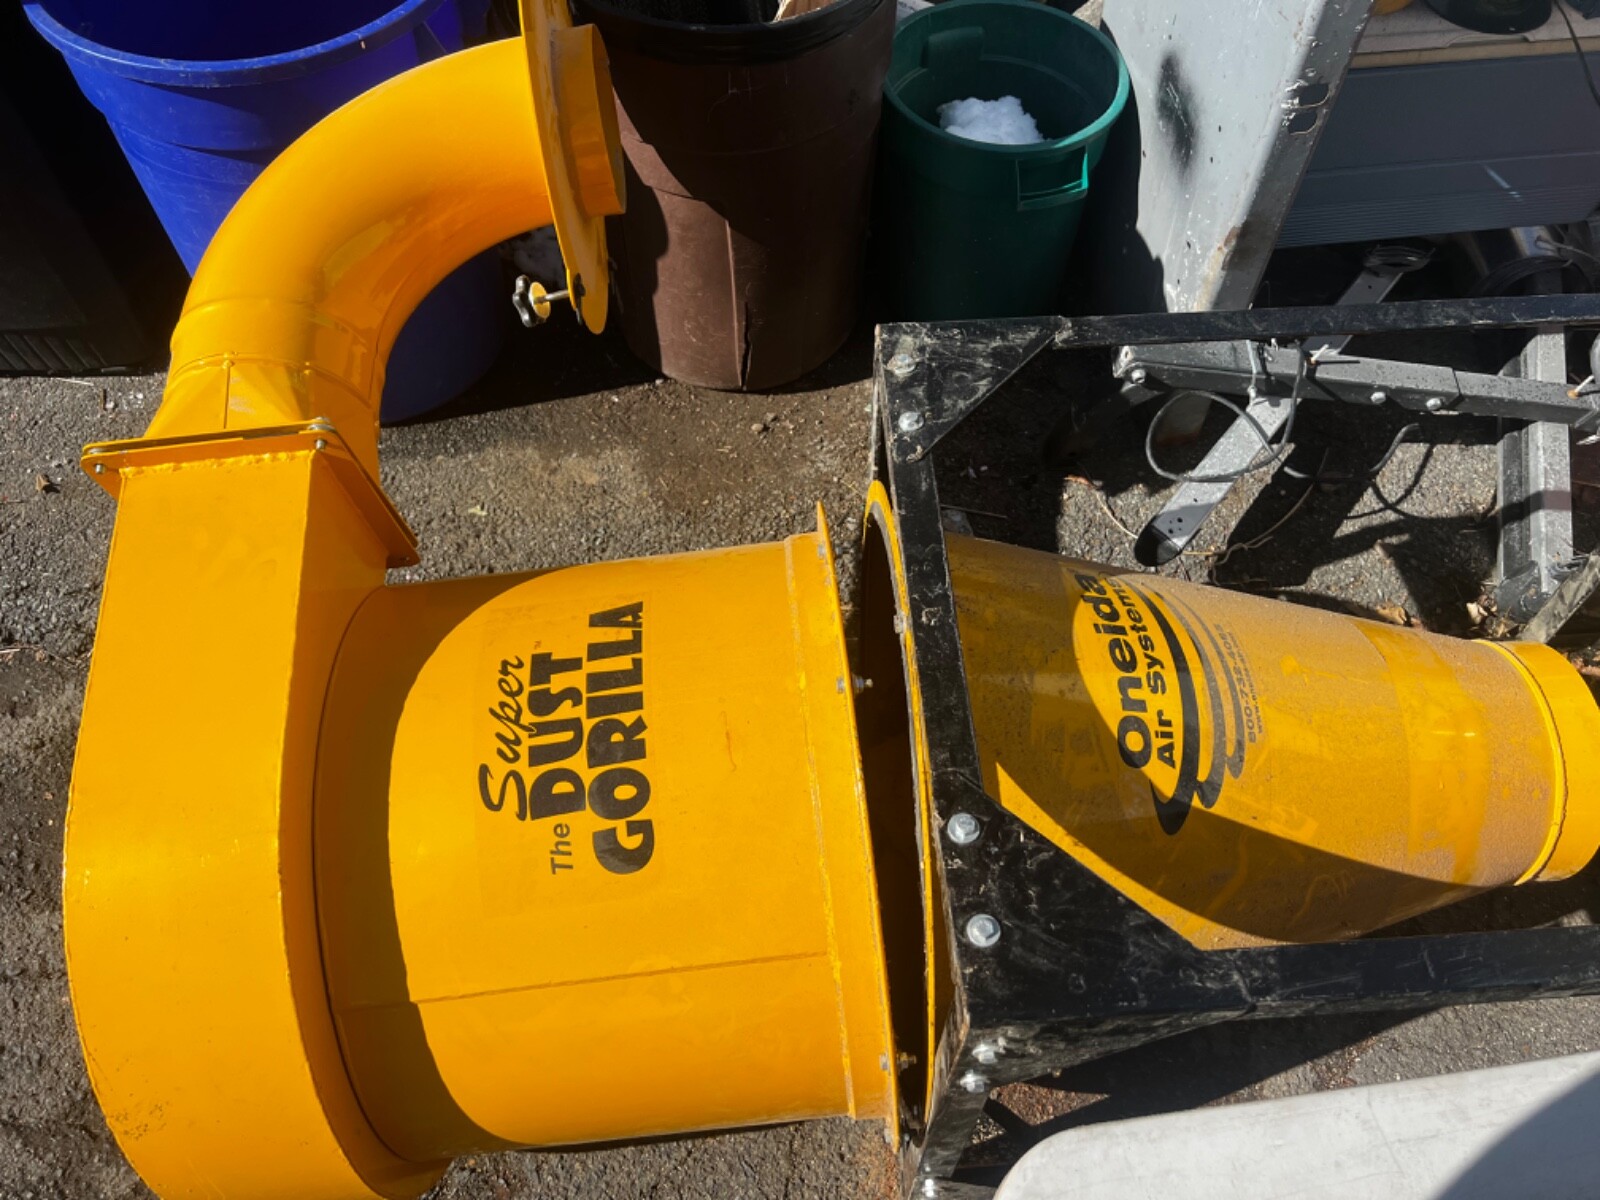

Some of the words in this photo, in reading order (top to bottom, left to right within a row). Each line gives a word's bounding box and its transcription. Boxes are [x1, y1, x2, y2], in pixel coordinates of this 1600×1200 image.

[1074, 573, 1152, 769] Oneida
[1106, 575, 1168, 696] Systems
[478, 655, 537, 822] Super
[527, 652, 586, 821] DUST
[585, 601, 655, 875] GORILLA
[1156, 709, 1176, 769] Air
[550, 822, 574, 875] The
